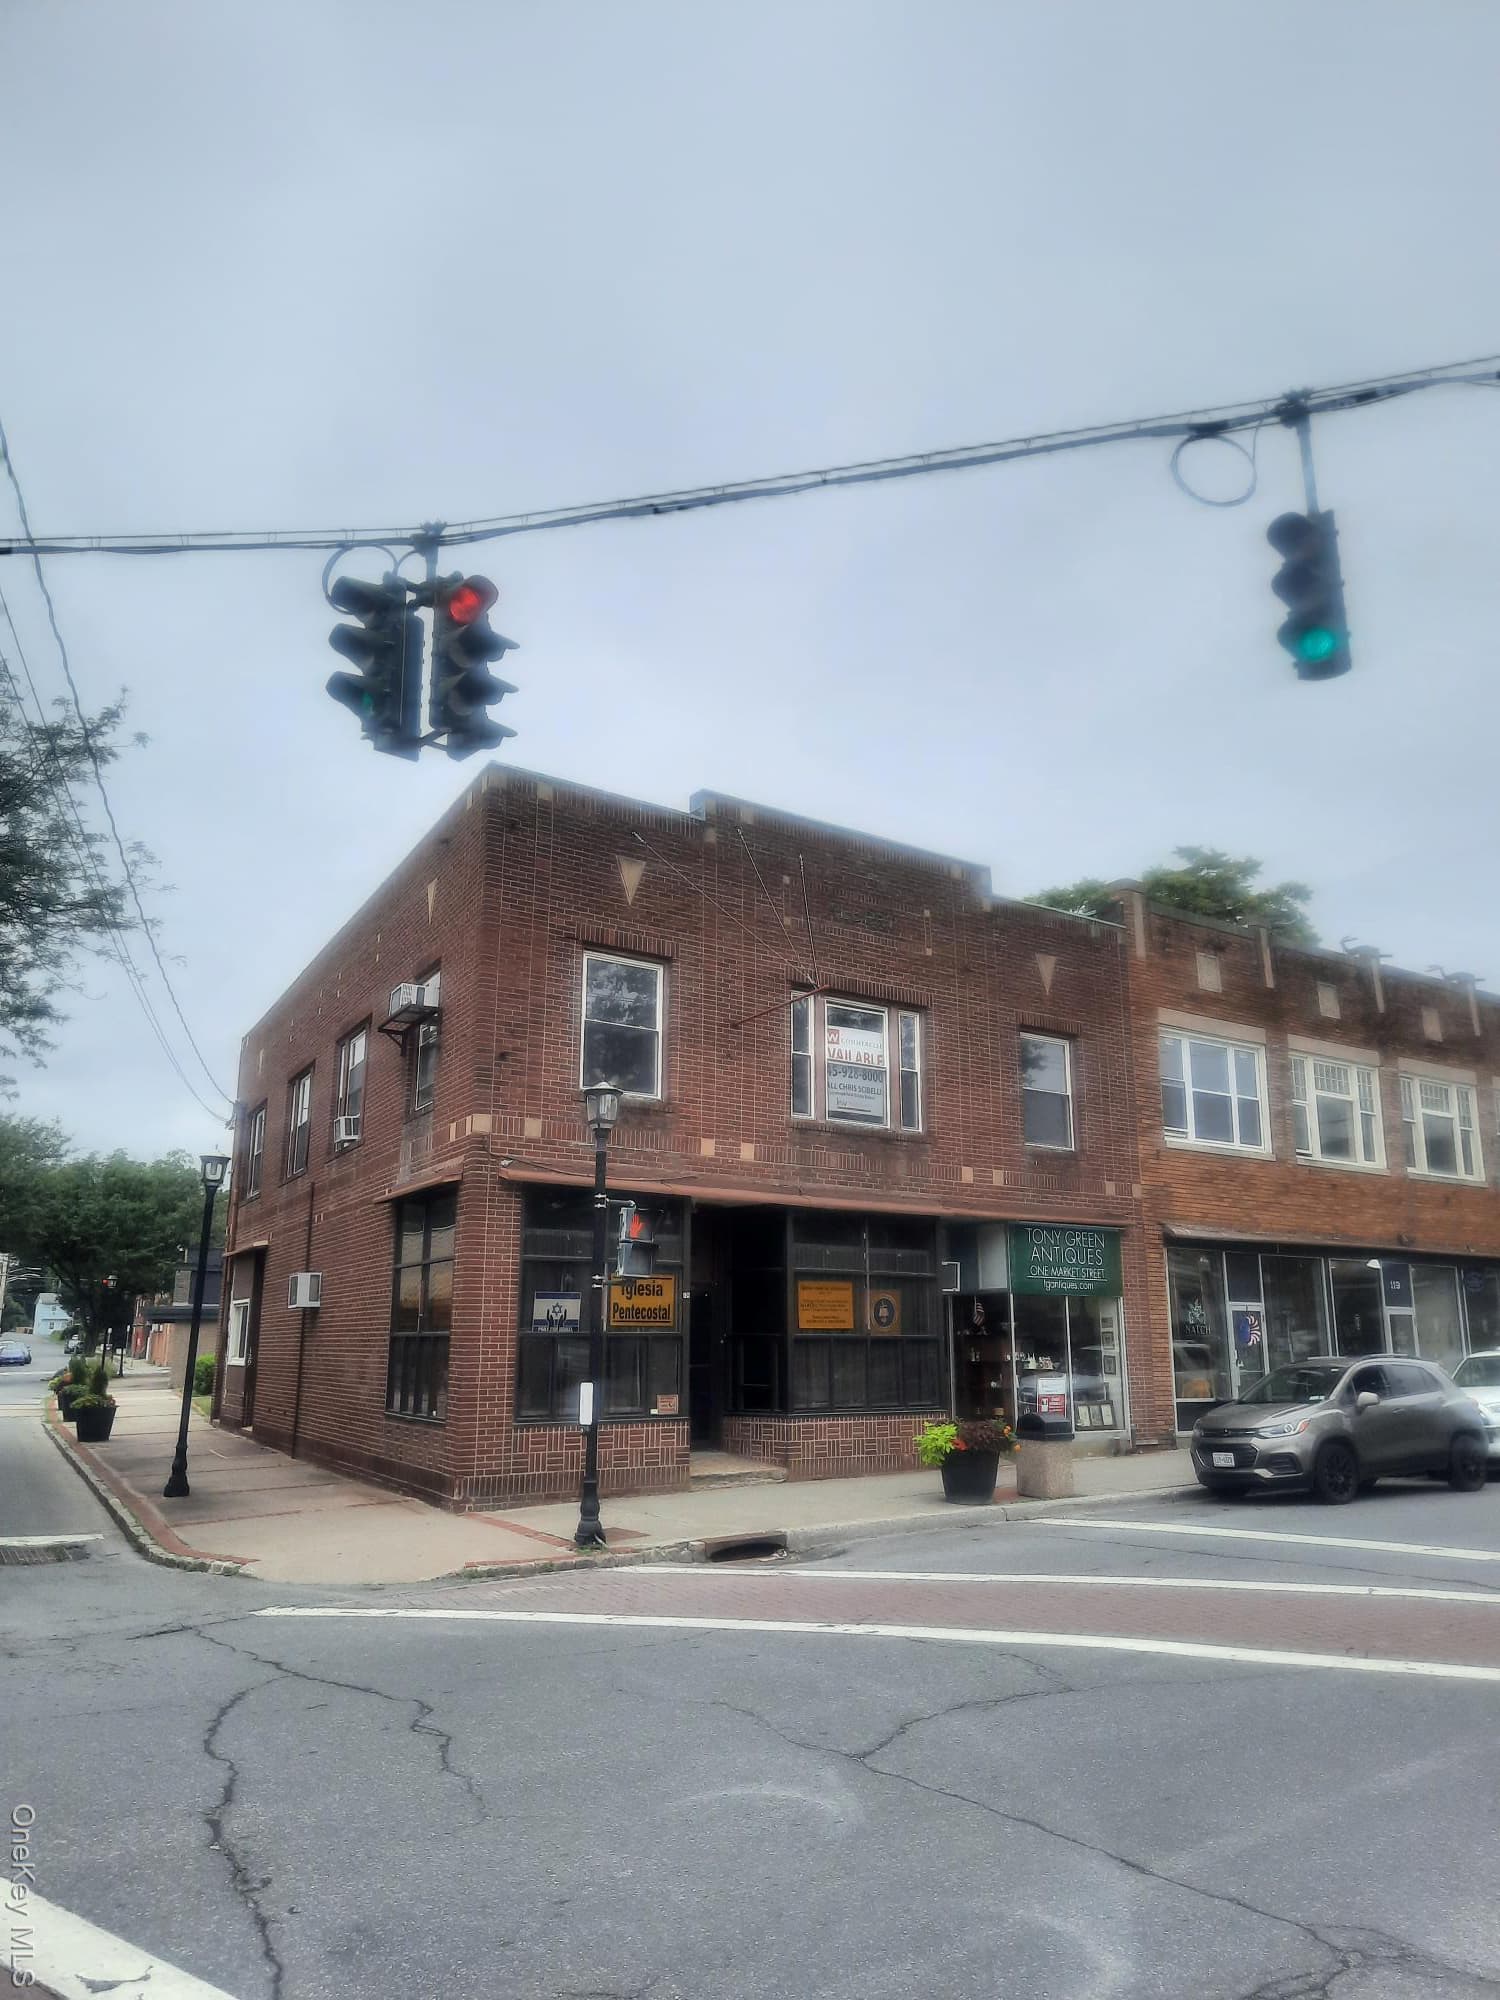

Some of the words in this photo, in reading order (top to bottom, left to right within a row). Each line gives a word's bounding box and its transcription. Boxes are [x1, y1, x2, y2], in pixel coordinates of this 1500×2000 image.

[828, 1047, 883, 1065] VAILABLE
[1024, 1227, 1061, 1245] TONY
[1065, 1230, 1105, 1249] GREEN
[1031, 1246, 1103, 1266] ANTIQUES
[1030, 1264, 1049, 1276] ONE
[1050, 1265, 1080, 1278] MARKET
[1081, 1267, 1105, 1279] STREET
[621, 1279, 663, 1300] Iglesia
[1043, 1279, 1095, 1292] tgantiques.com
[612, 1302, 671, 1320] Pentecostal
